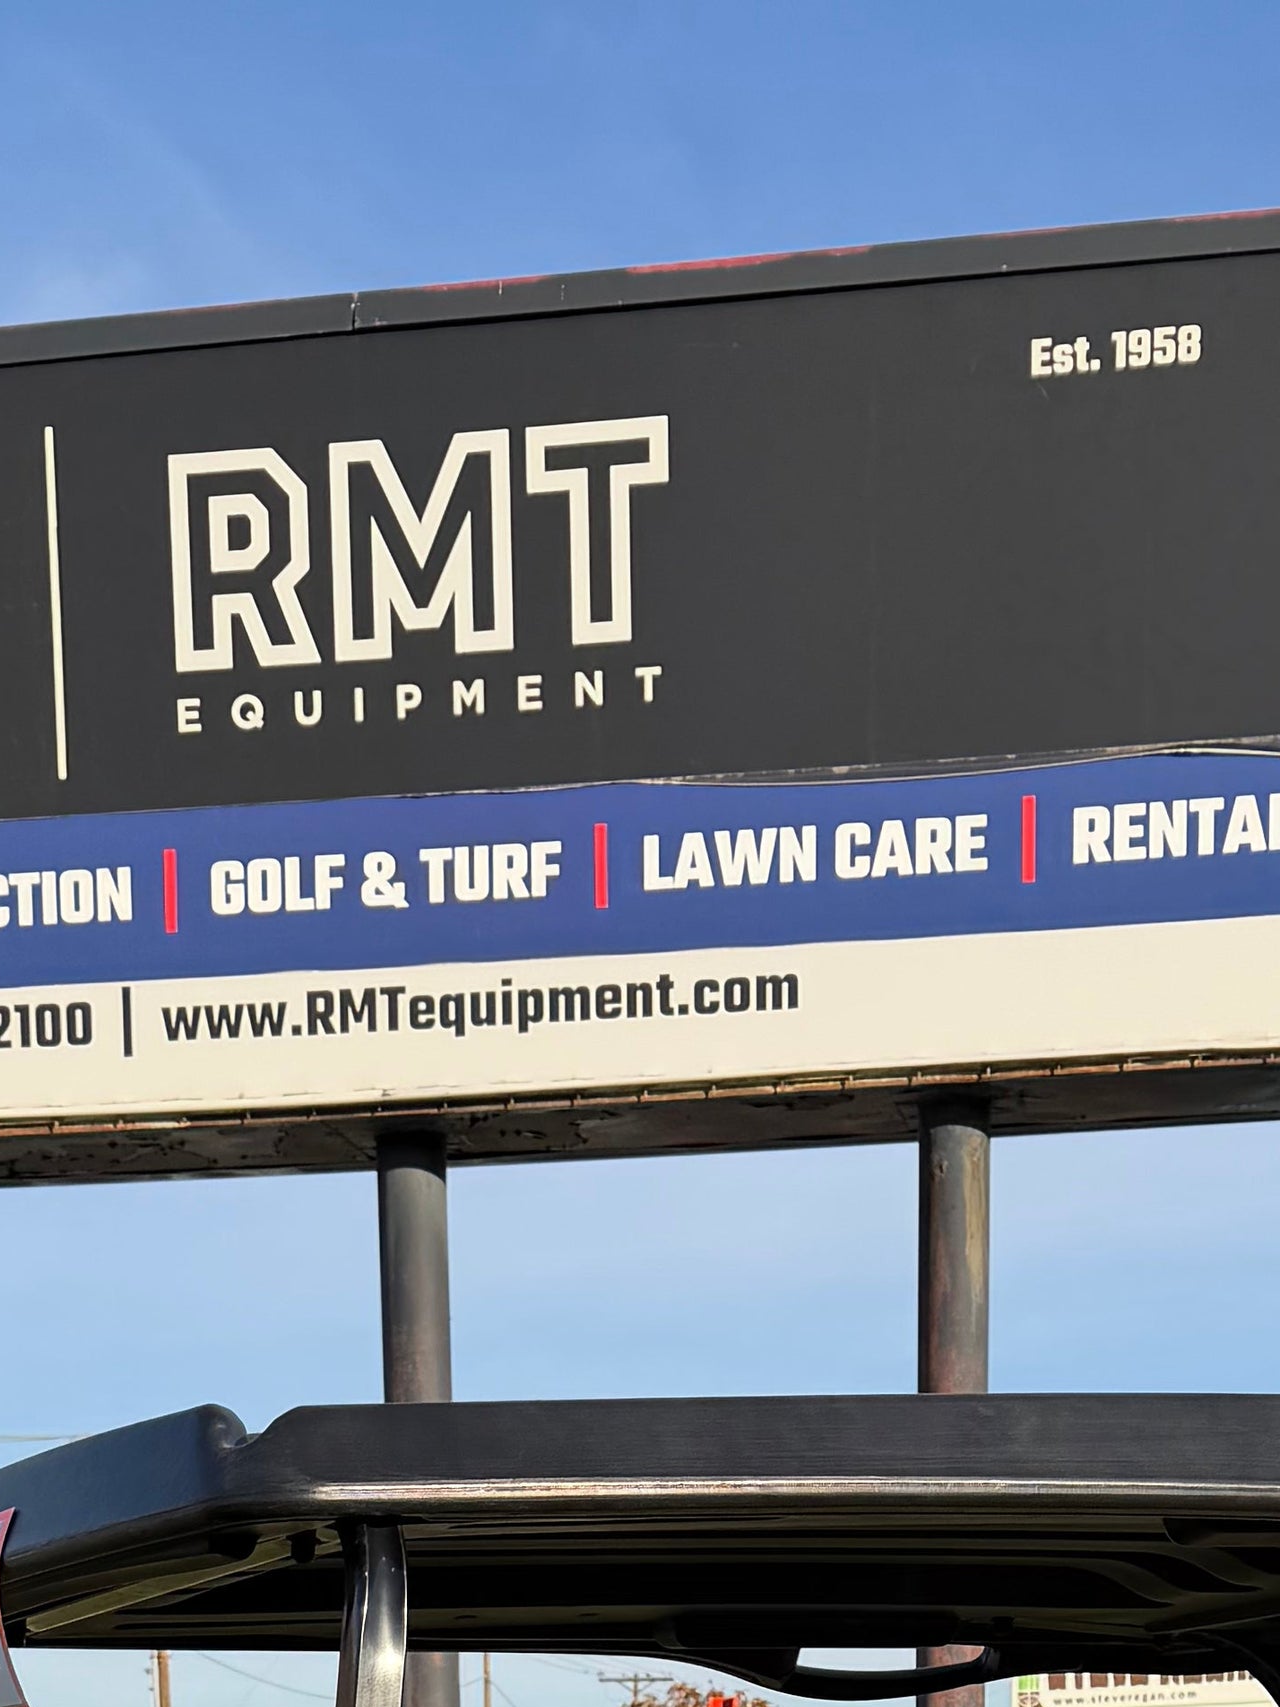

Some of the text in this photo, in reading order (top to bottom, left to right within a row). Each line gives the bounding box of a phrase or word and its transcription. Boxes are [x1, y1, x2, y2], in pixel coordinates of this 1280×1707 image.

[1030, 324, 1202, 378] Est. 1958
[167, 414, 669, 673] RMT
[176, 665, 663, 733] EQUIPMENT
[209, 840, 563, 916] GOLF & TURF
[642, 814, 989, 892] LAWN CARE
[162, 972, 800, 1042] www.RMTequipment.com
